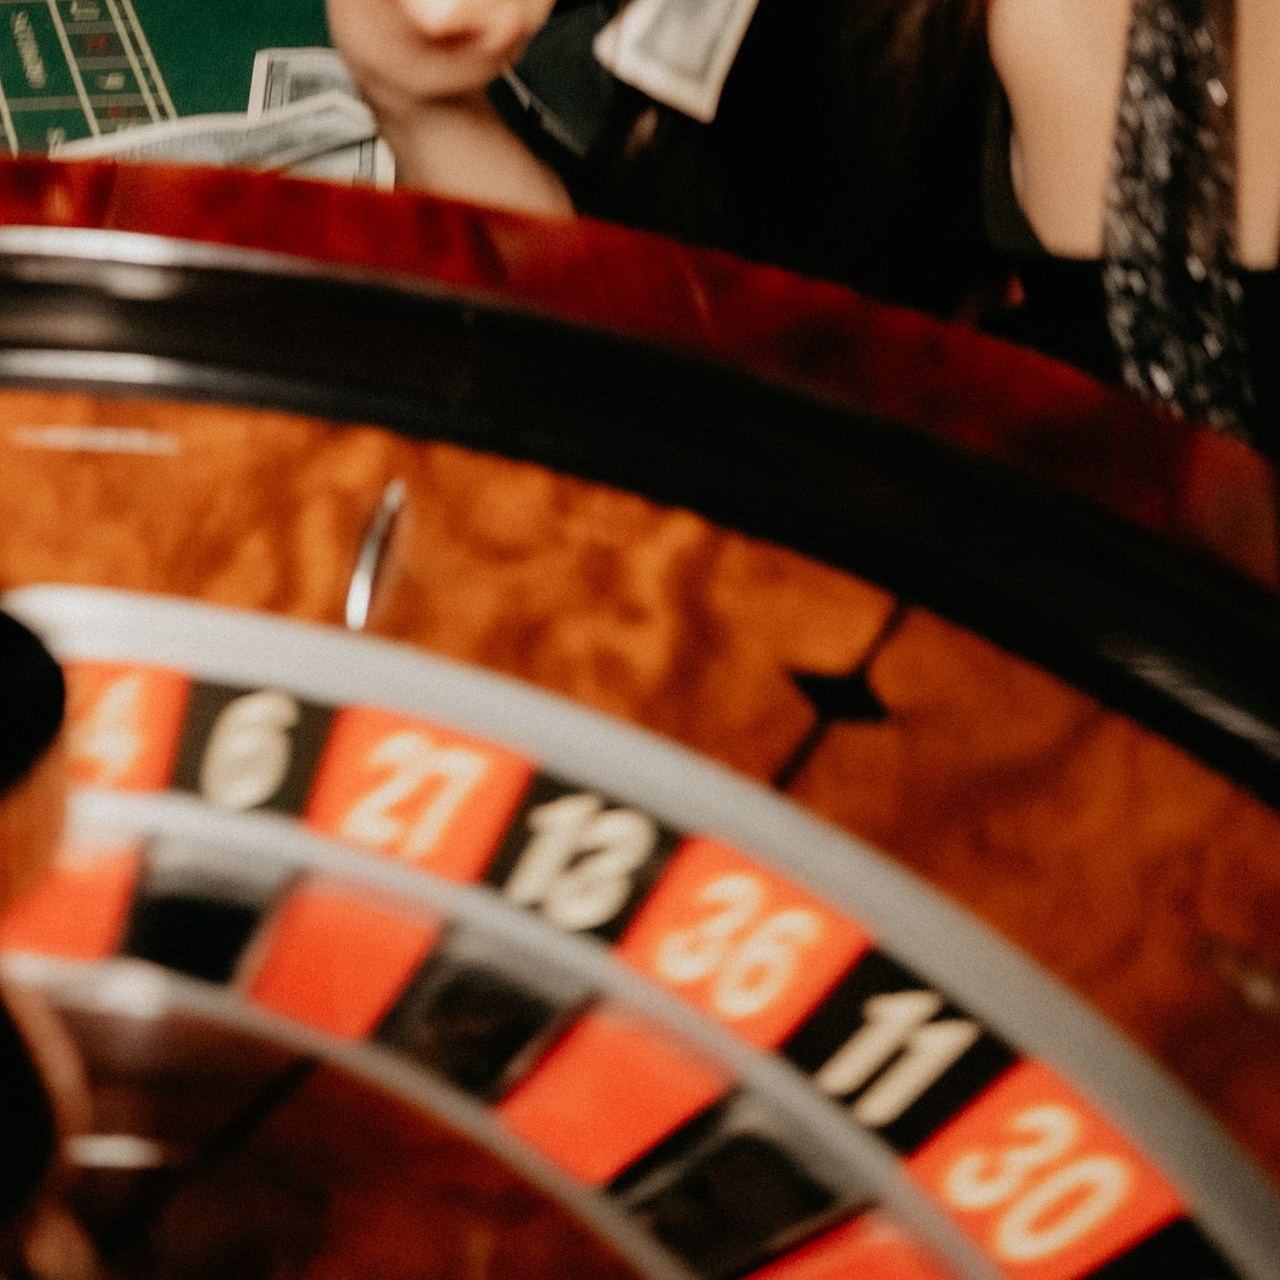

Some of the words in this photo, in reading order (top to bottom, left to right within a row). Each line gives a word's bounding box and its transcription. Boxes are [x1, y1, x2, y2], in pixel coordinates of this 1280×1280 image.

[202, 689, 300, 812] 6
[340, 732, 492, 860] 27
[508, 790, 658, 932] 13
[654, 872, 822, 1020] 36
[818, 987, 982, 1130] 11
[942, 1102, 1132, 1263] 30
